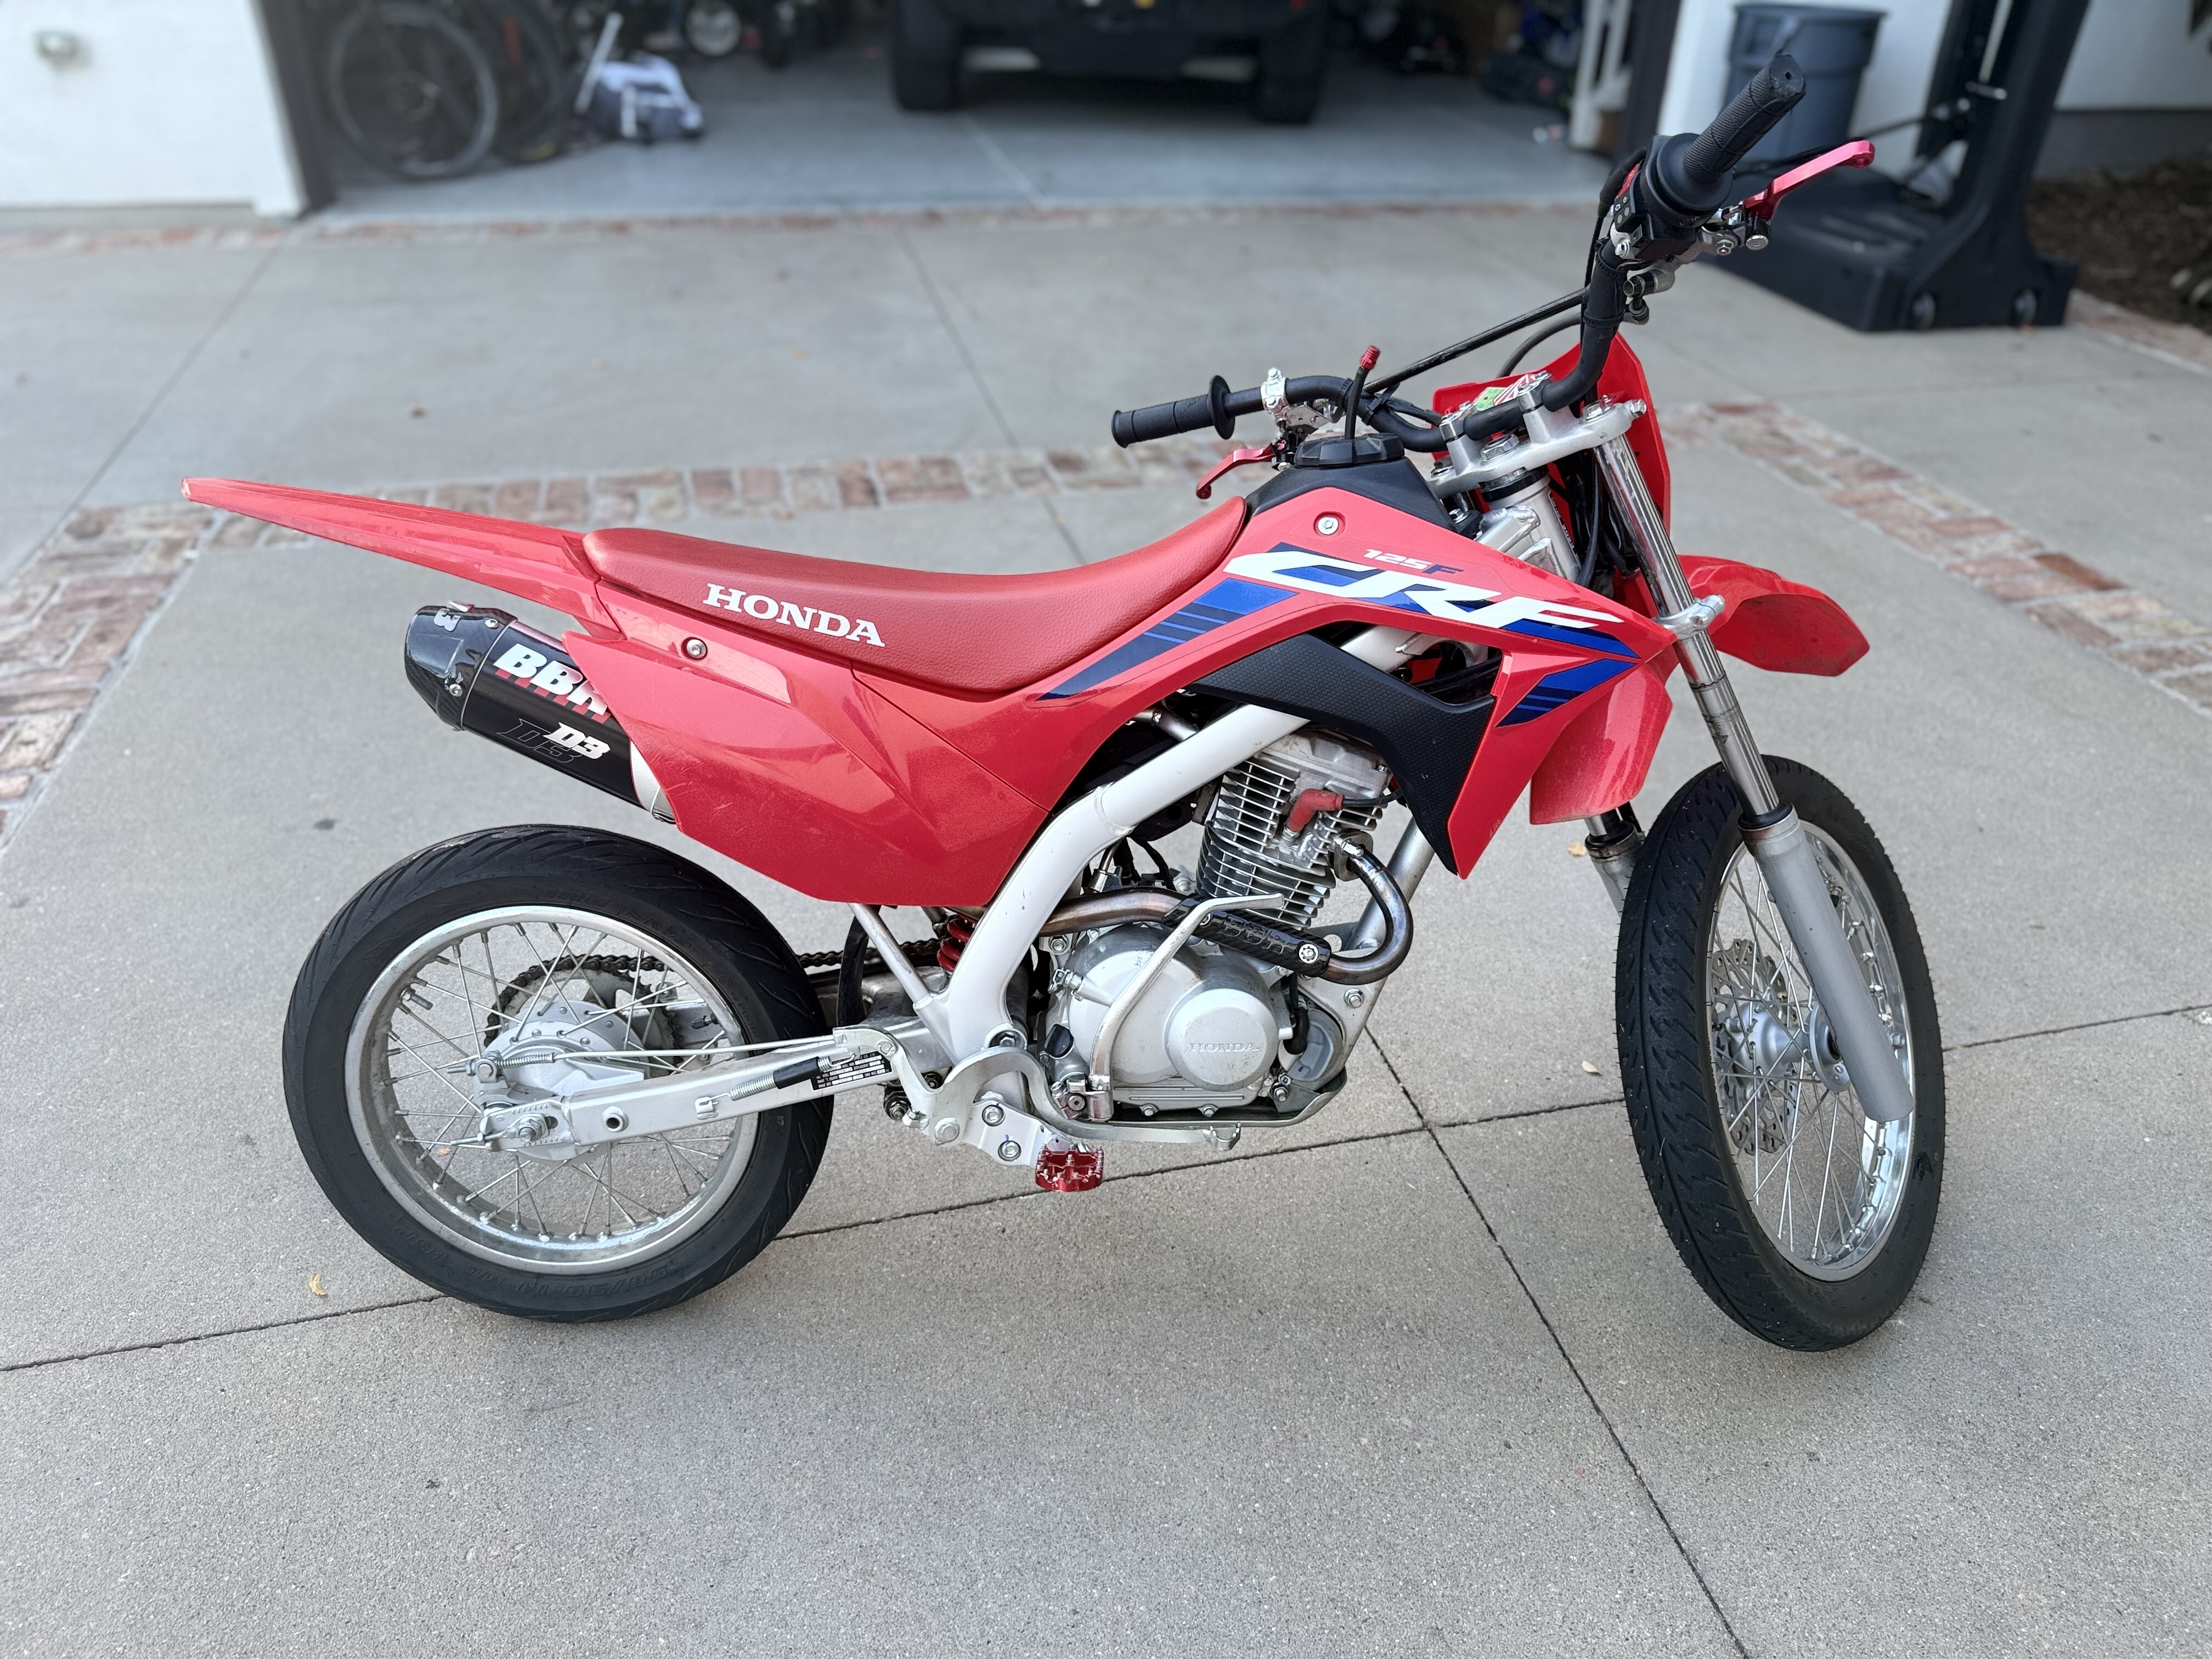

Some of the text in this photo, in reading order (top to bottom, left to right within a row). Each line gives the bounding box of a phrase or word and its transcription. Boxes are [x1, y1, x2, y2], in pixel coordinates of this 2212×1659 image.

[1363, 548, 1465, 575] 125F
[1222, 551, 1625, 629] CRF
[703, 583, 885, 647] HONDA
[543, 722, 611, 759] D3
[1189, 1042, 1260, 1053] HONDA
